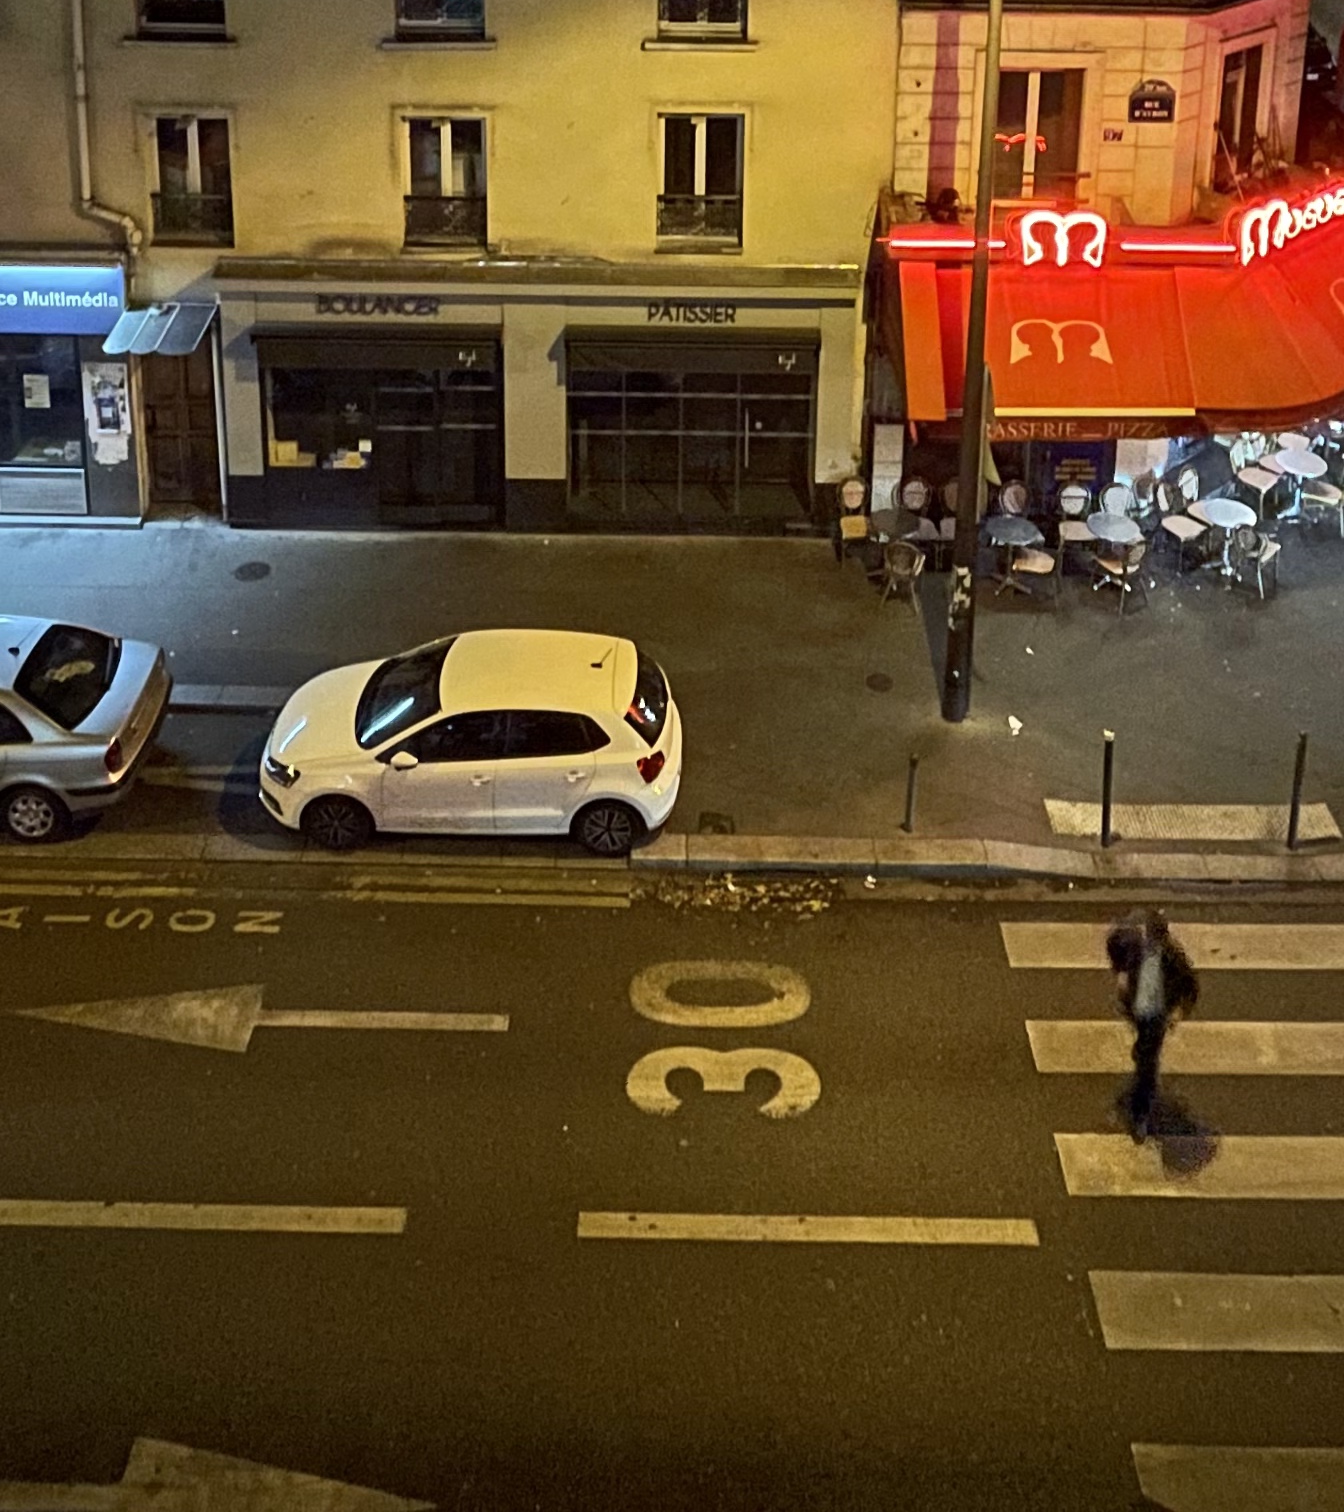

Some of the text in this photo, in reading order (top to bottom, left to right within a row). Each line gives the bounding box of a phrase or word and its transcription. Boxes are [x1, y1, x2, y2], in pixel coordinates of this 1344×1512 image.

[22, 290, 119, 308] Multimédia
[316, 294, 441, 316] BOULANGER
[985, 420, 1170, 438] RASSERIE PIZZA
[625, 958, 822, 1120] 30
